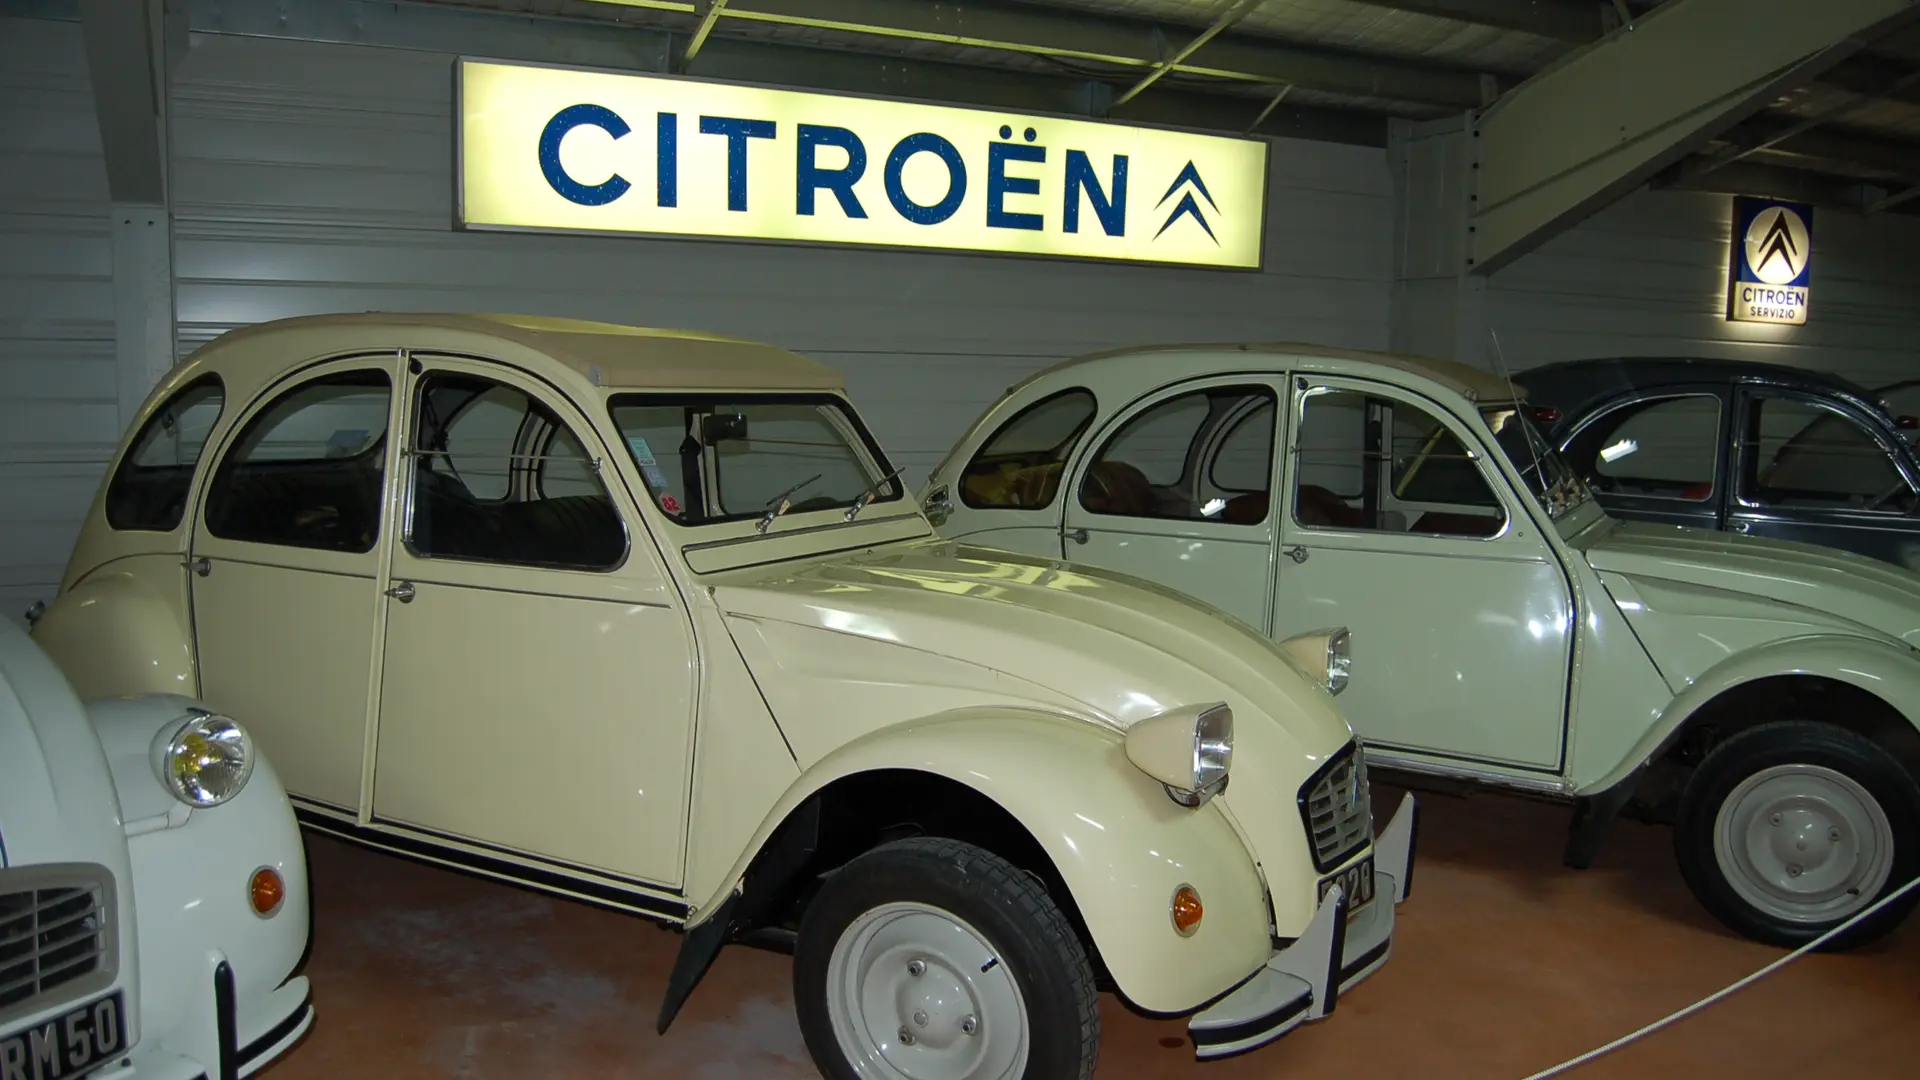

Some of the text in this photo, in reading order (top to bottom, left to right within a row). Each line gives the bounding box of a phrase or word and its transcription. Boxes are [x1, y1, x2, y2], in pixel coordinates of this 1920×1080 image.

[538, 103, 1129, 237] CITROËN
[1743, 287, 1804, 306] CITROËN
[1750, 306, 1795, 319] SERVIZIO
